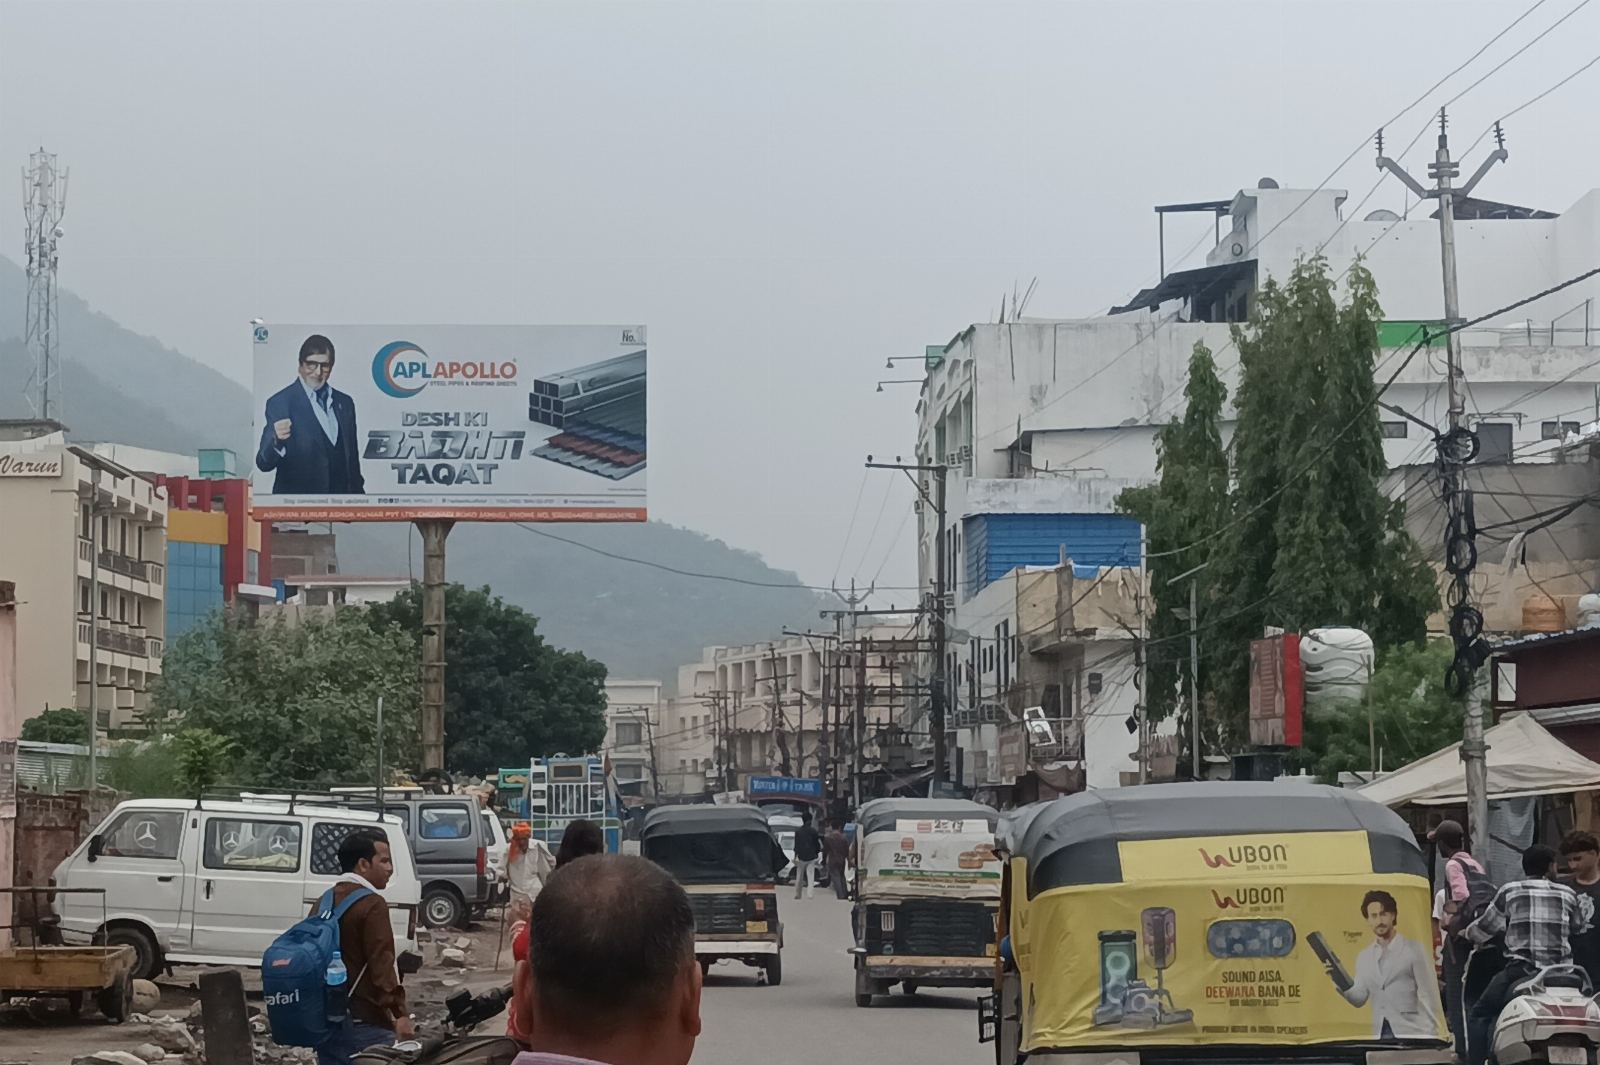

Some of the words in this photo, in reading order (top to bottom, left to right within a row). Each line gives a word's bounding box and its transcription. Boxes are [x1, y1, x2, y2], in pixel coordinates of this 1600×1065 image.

[401, 411, 460, 426] DESH
[464, 412, 488, 426] KI
[0, 454, 58, 474] Varun
[391, 463, 499, 486] TAQAT
[1236, 887, 1284, 904] UBON
[1222, 971, 1256, 983] SOUND
[1258, 985, 1285, 998] BANA
[1289, 985, 1301, 998] DE
